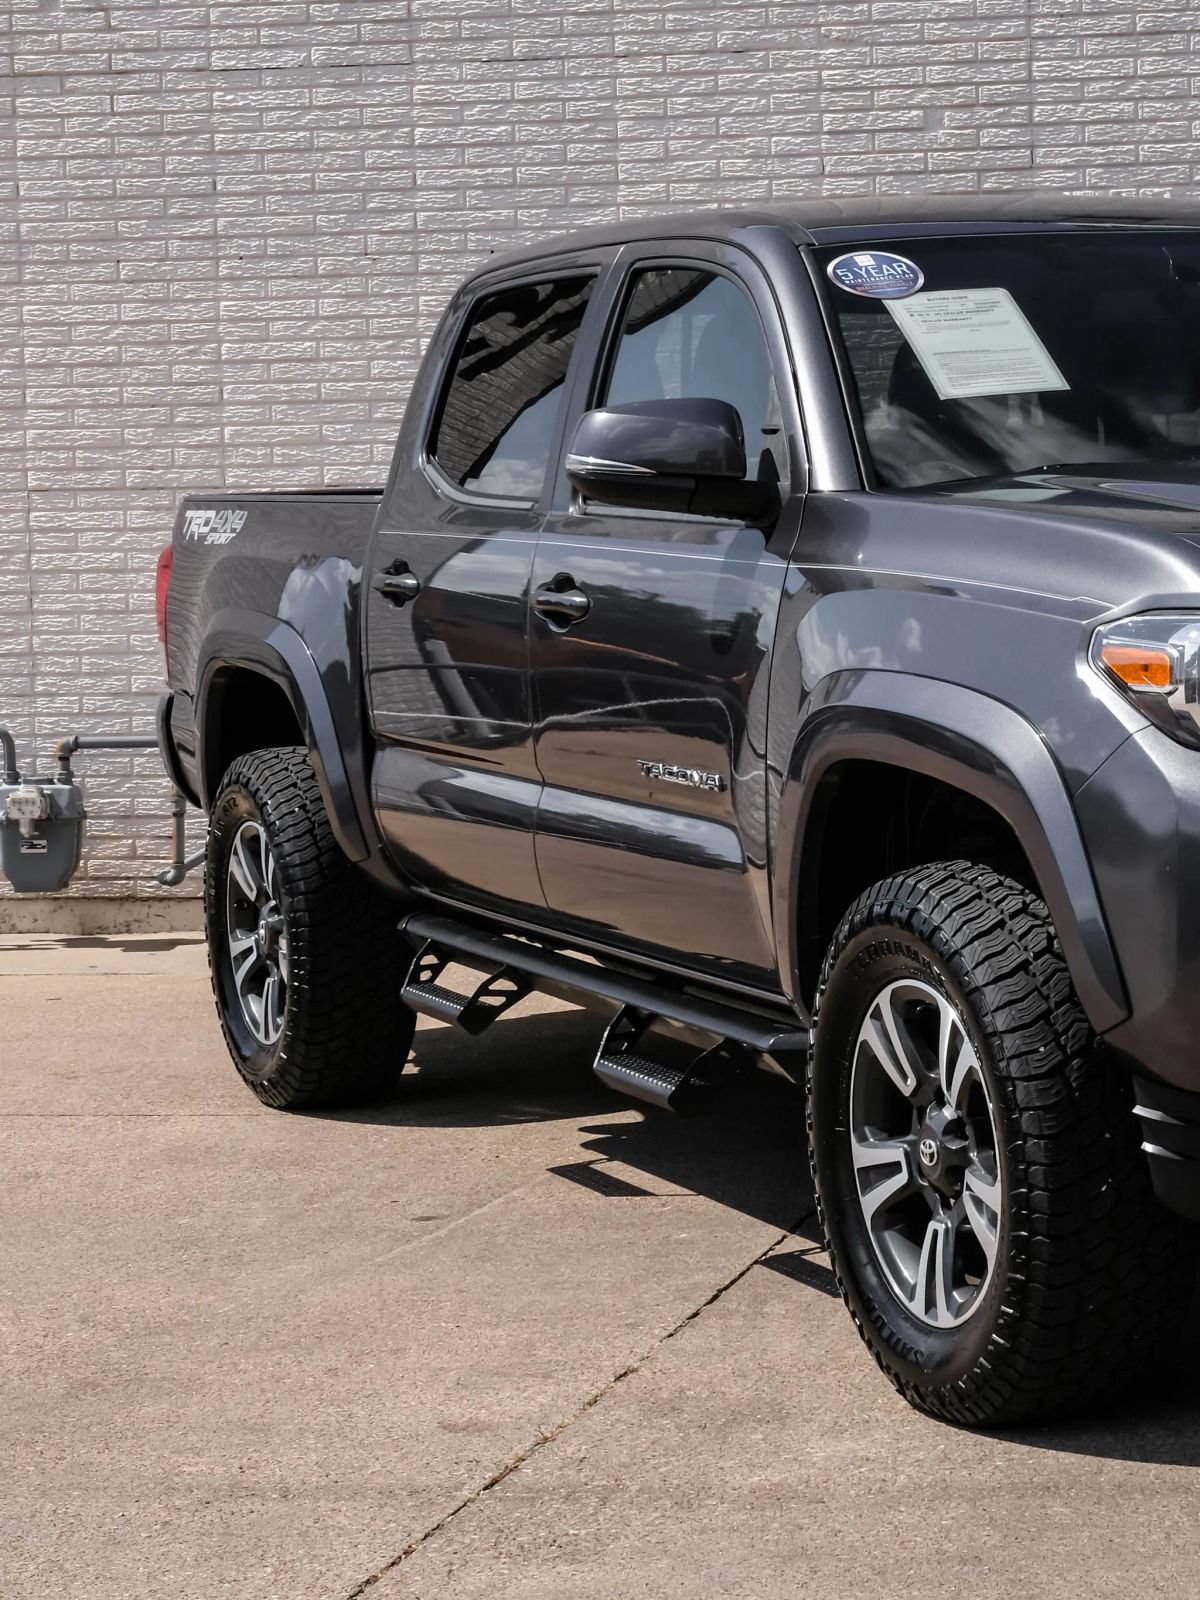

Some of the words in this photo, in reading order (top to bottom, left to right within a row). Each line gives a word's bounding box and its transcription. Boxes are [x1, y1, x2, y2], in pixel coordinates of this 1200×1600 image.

[836, 268, 854, 281] 5
[853, 262, 911, 278] YEAR
[183, 510, 217, 541] TRD
[203, 532, 237, 545] SPORT
[636, 759, 720, 792] TACOMA
